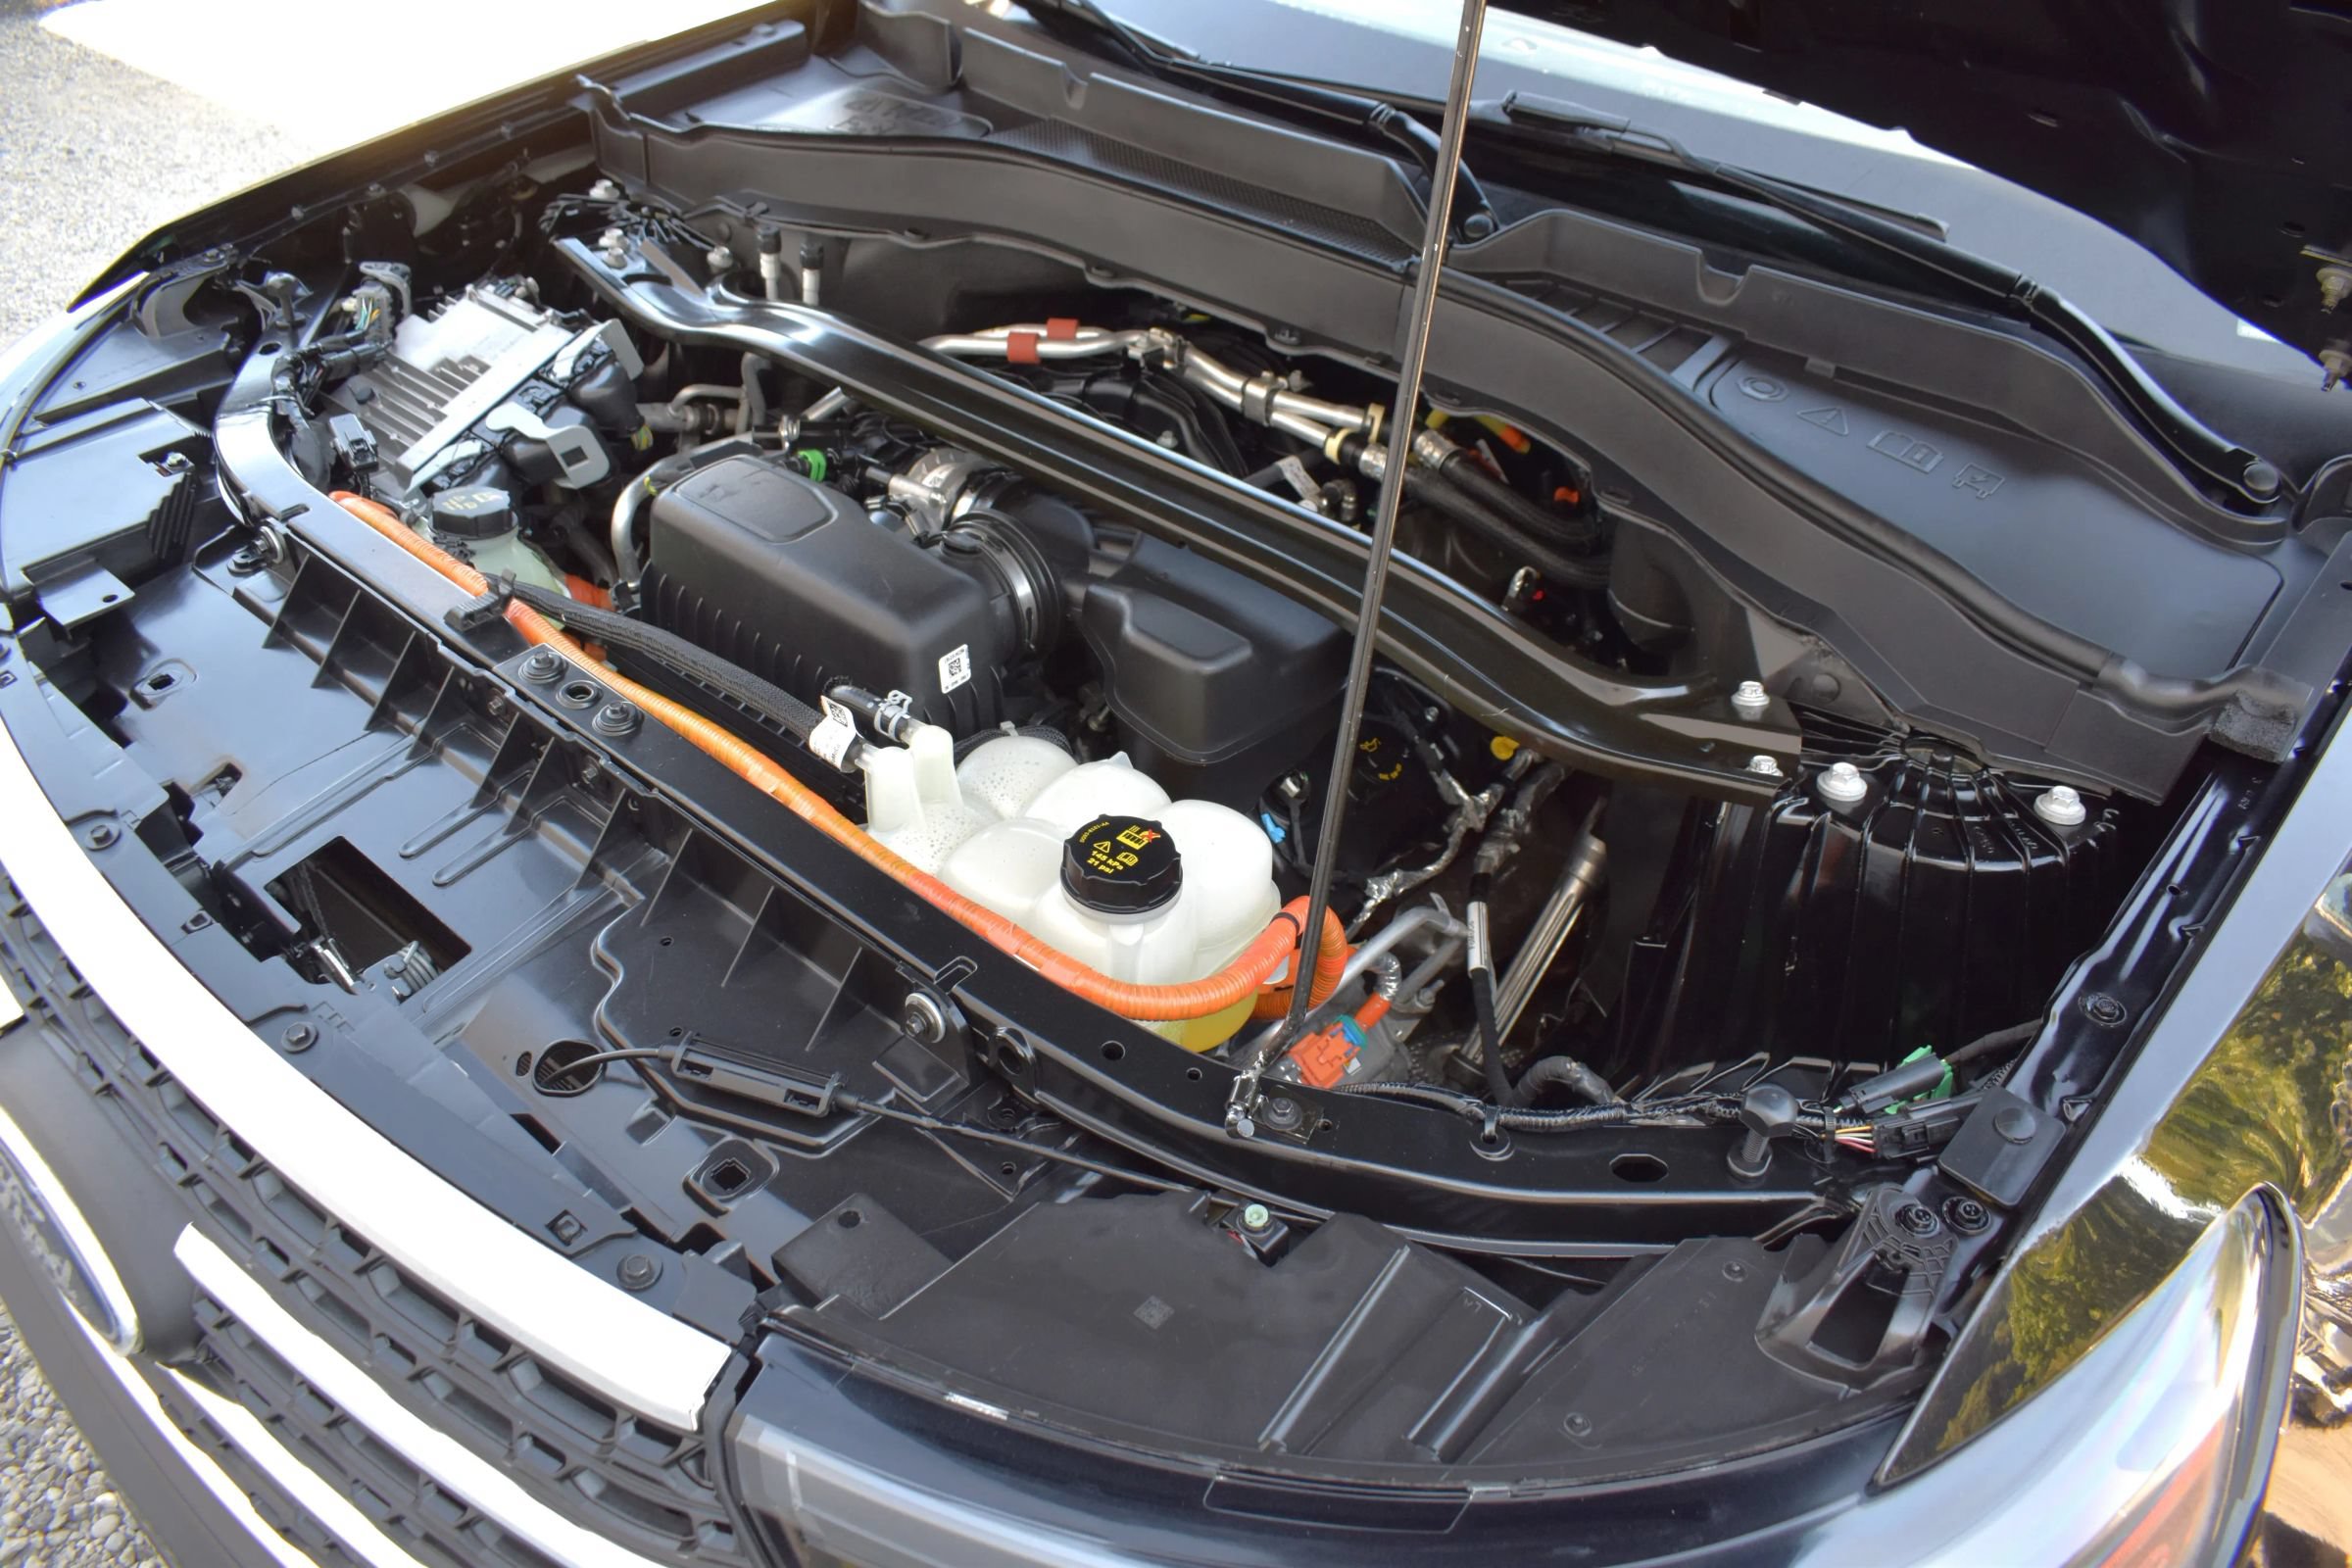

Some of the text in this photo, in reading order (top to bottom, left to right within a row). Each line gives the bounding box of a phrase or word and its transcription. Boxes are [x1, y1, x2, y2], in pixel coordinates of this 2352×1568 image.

[1087, 858, 1114, 874] 21 psi
[1092, 850, 1123, 870] 145 kPa
